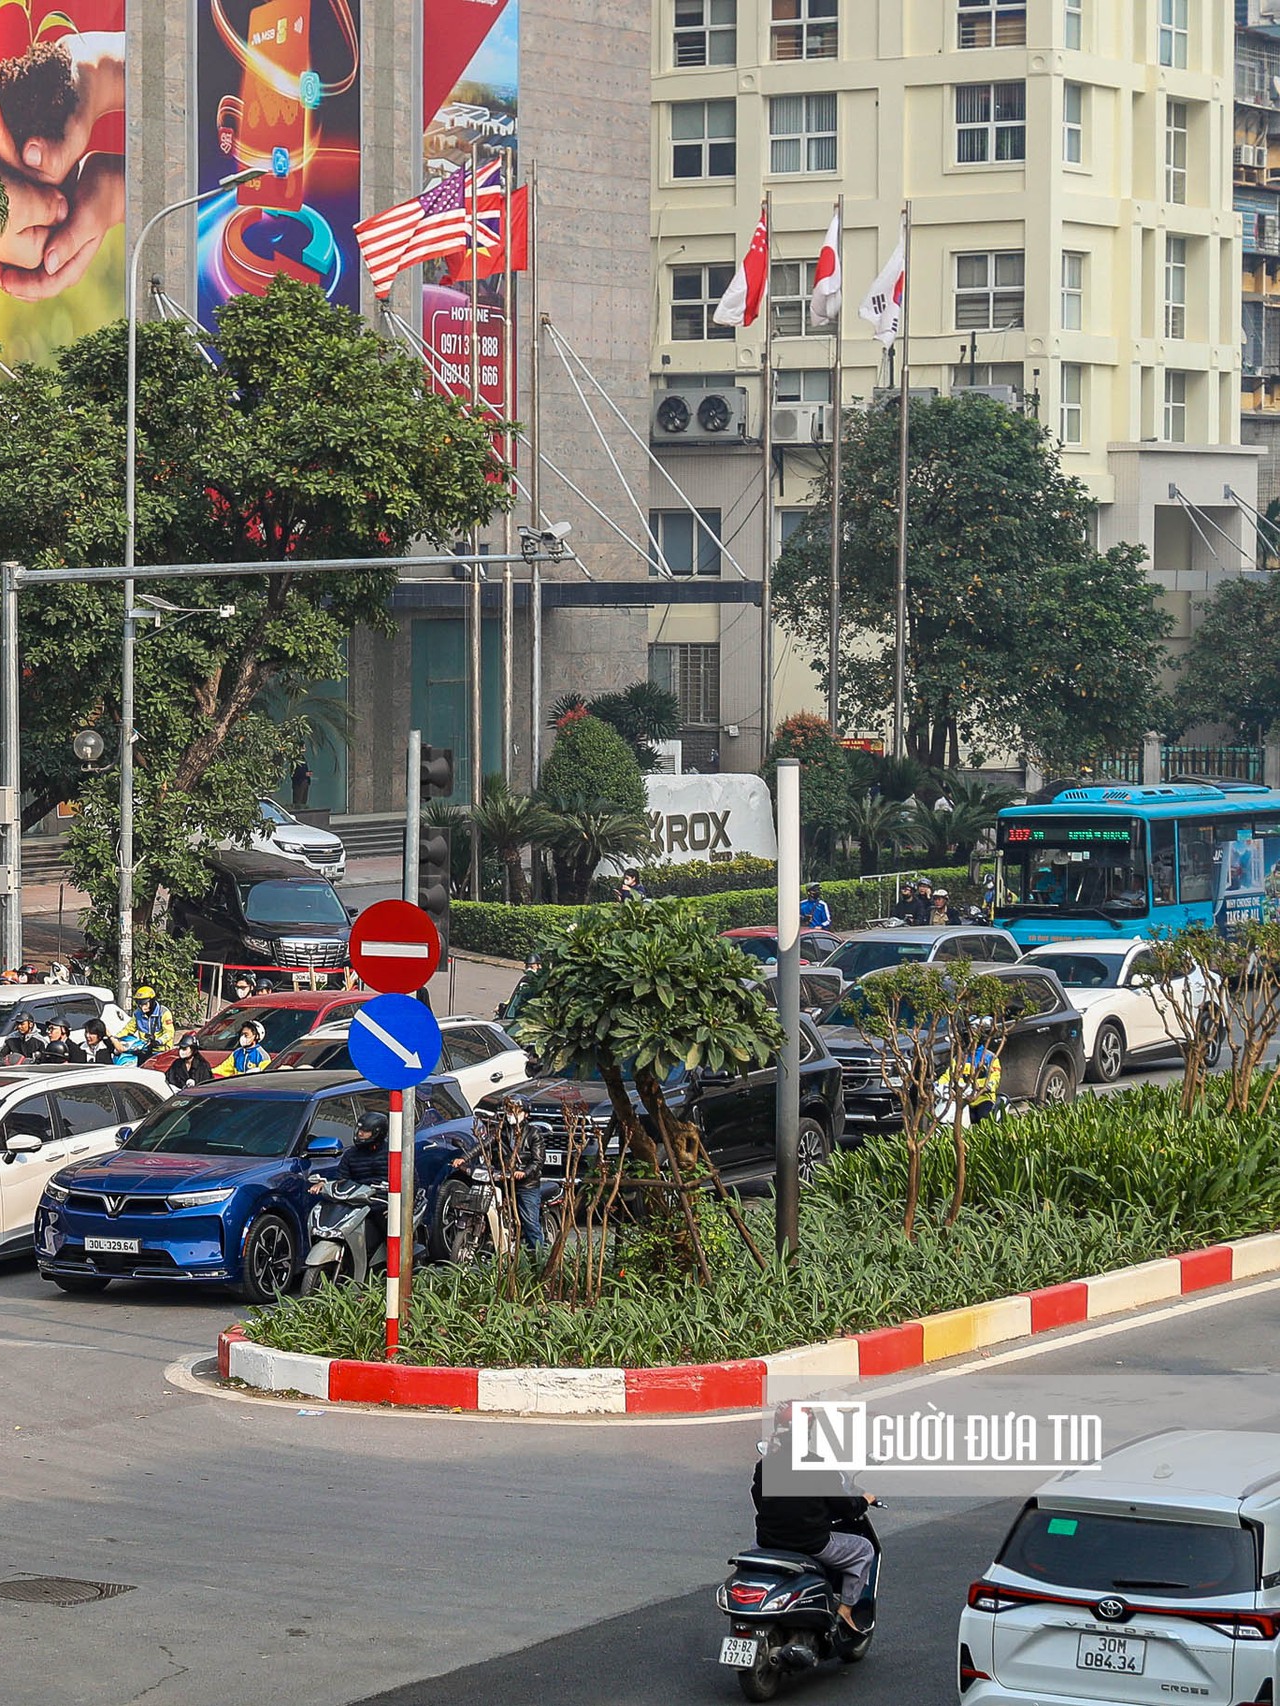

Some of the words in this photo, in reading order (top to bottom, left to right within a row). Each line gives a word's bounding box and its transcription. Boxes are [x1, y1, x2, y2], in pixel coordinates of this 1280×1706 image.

[452, 306, 489, 322] HOTNE
[441, 334, 462, 354] 0971
[482, 336, 498, 356] 888
[482, 366, 498, 386] 666
[666, 810, 732, 853] ROX
[90, 1240, 134, 1250] 30L-329.64
[1065, 1621, 1156, 1636] VELOZ
[1098, 1638, 1126, 1653] 30M
[723, 1651, 752, 1665] 137.43
[1085, 1652, 1136, 1671] 084.34
[1161, 1684, 1209, 1695] CROSS
